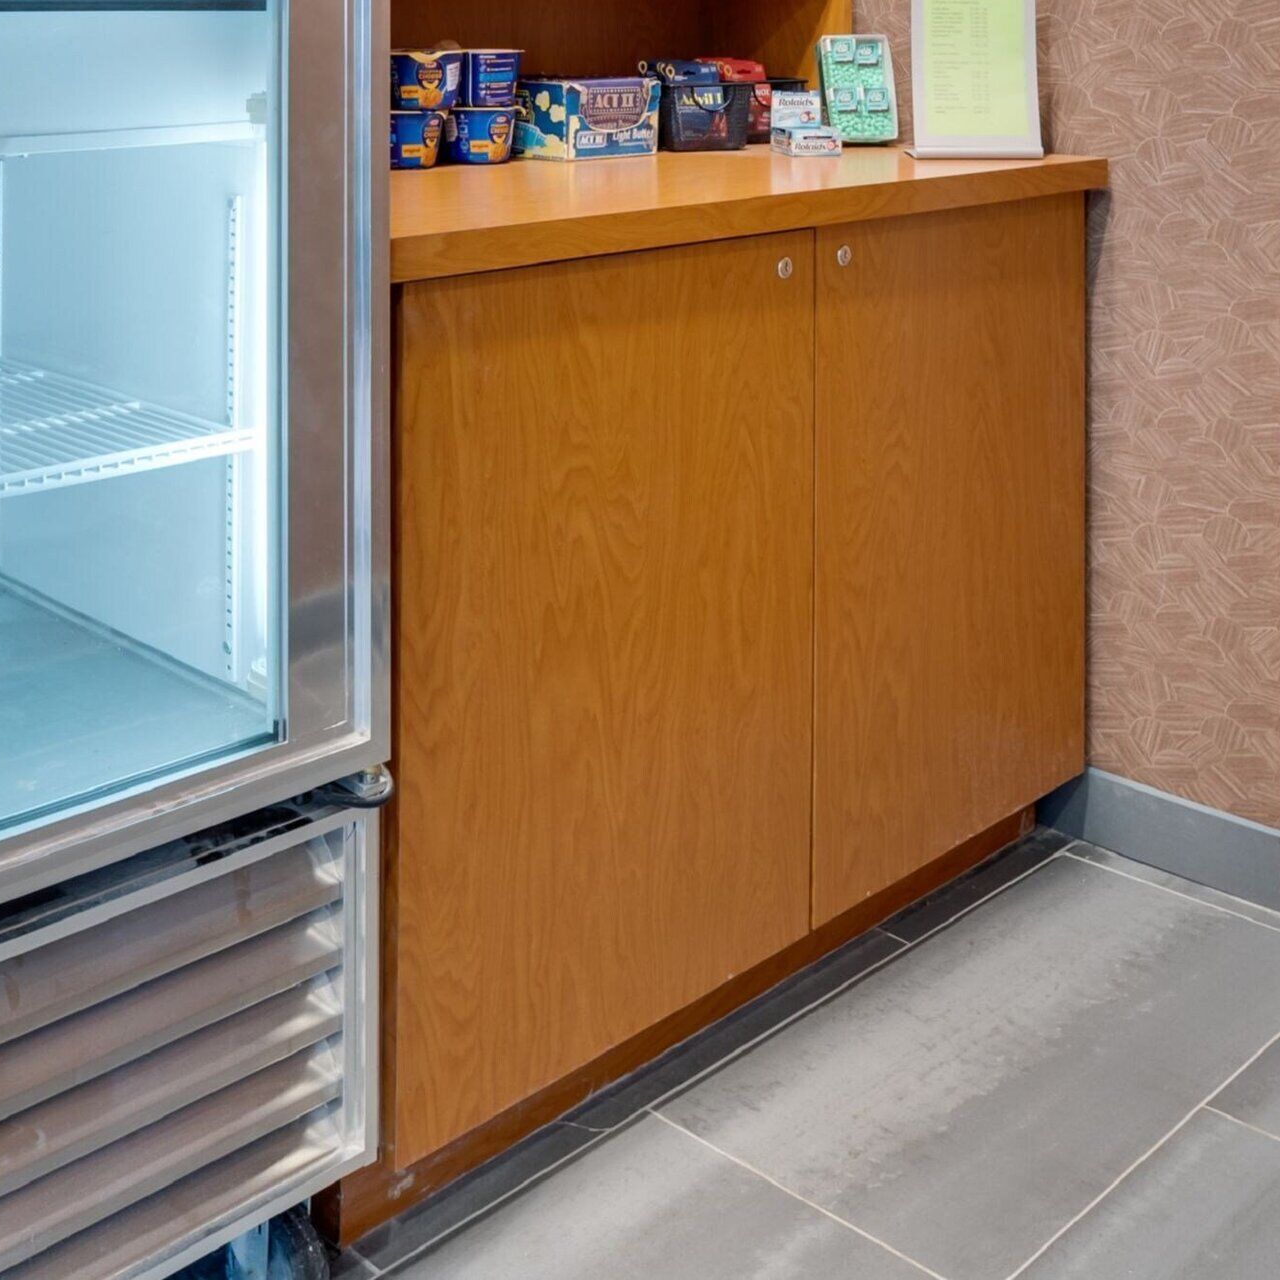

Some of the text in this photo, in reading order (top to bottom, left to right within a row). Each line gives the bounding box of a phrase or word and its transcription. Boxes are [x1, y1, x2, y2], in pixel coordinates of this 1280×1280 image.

[594, 94, 620, 108] ACT
[778, 97, 814, 106] Rolaids
[794, 142, 826, 151] Rolaids
